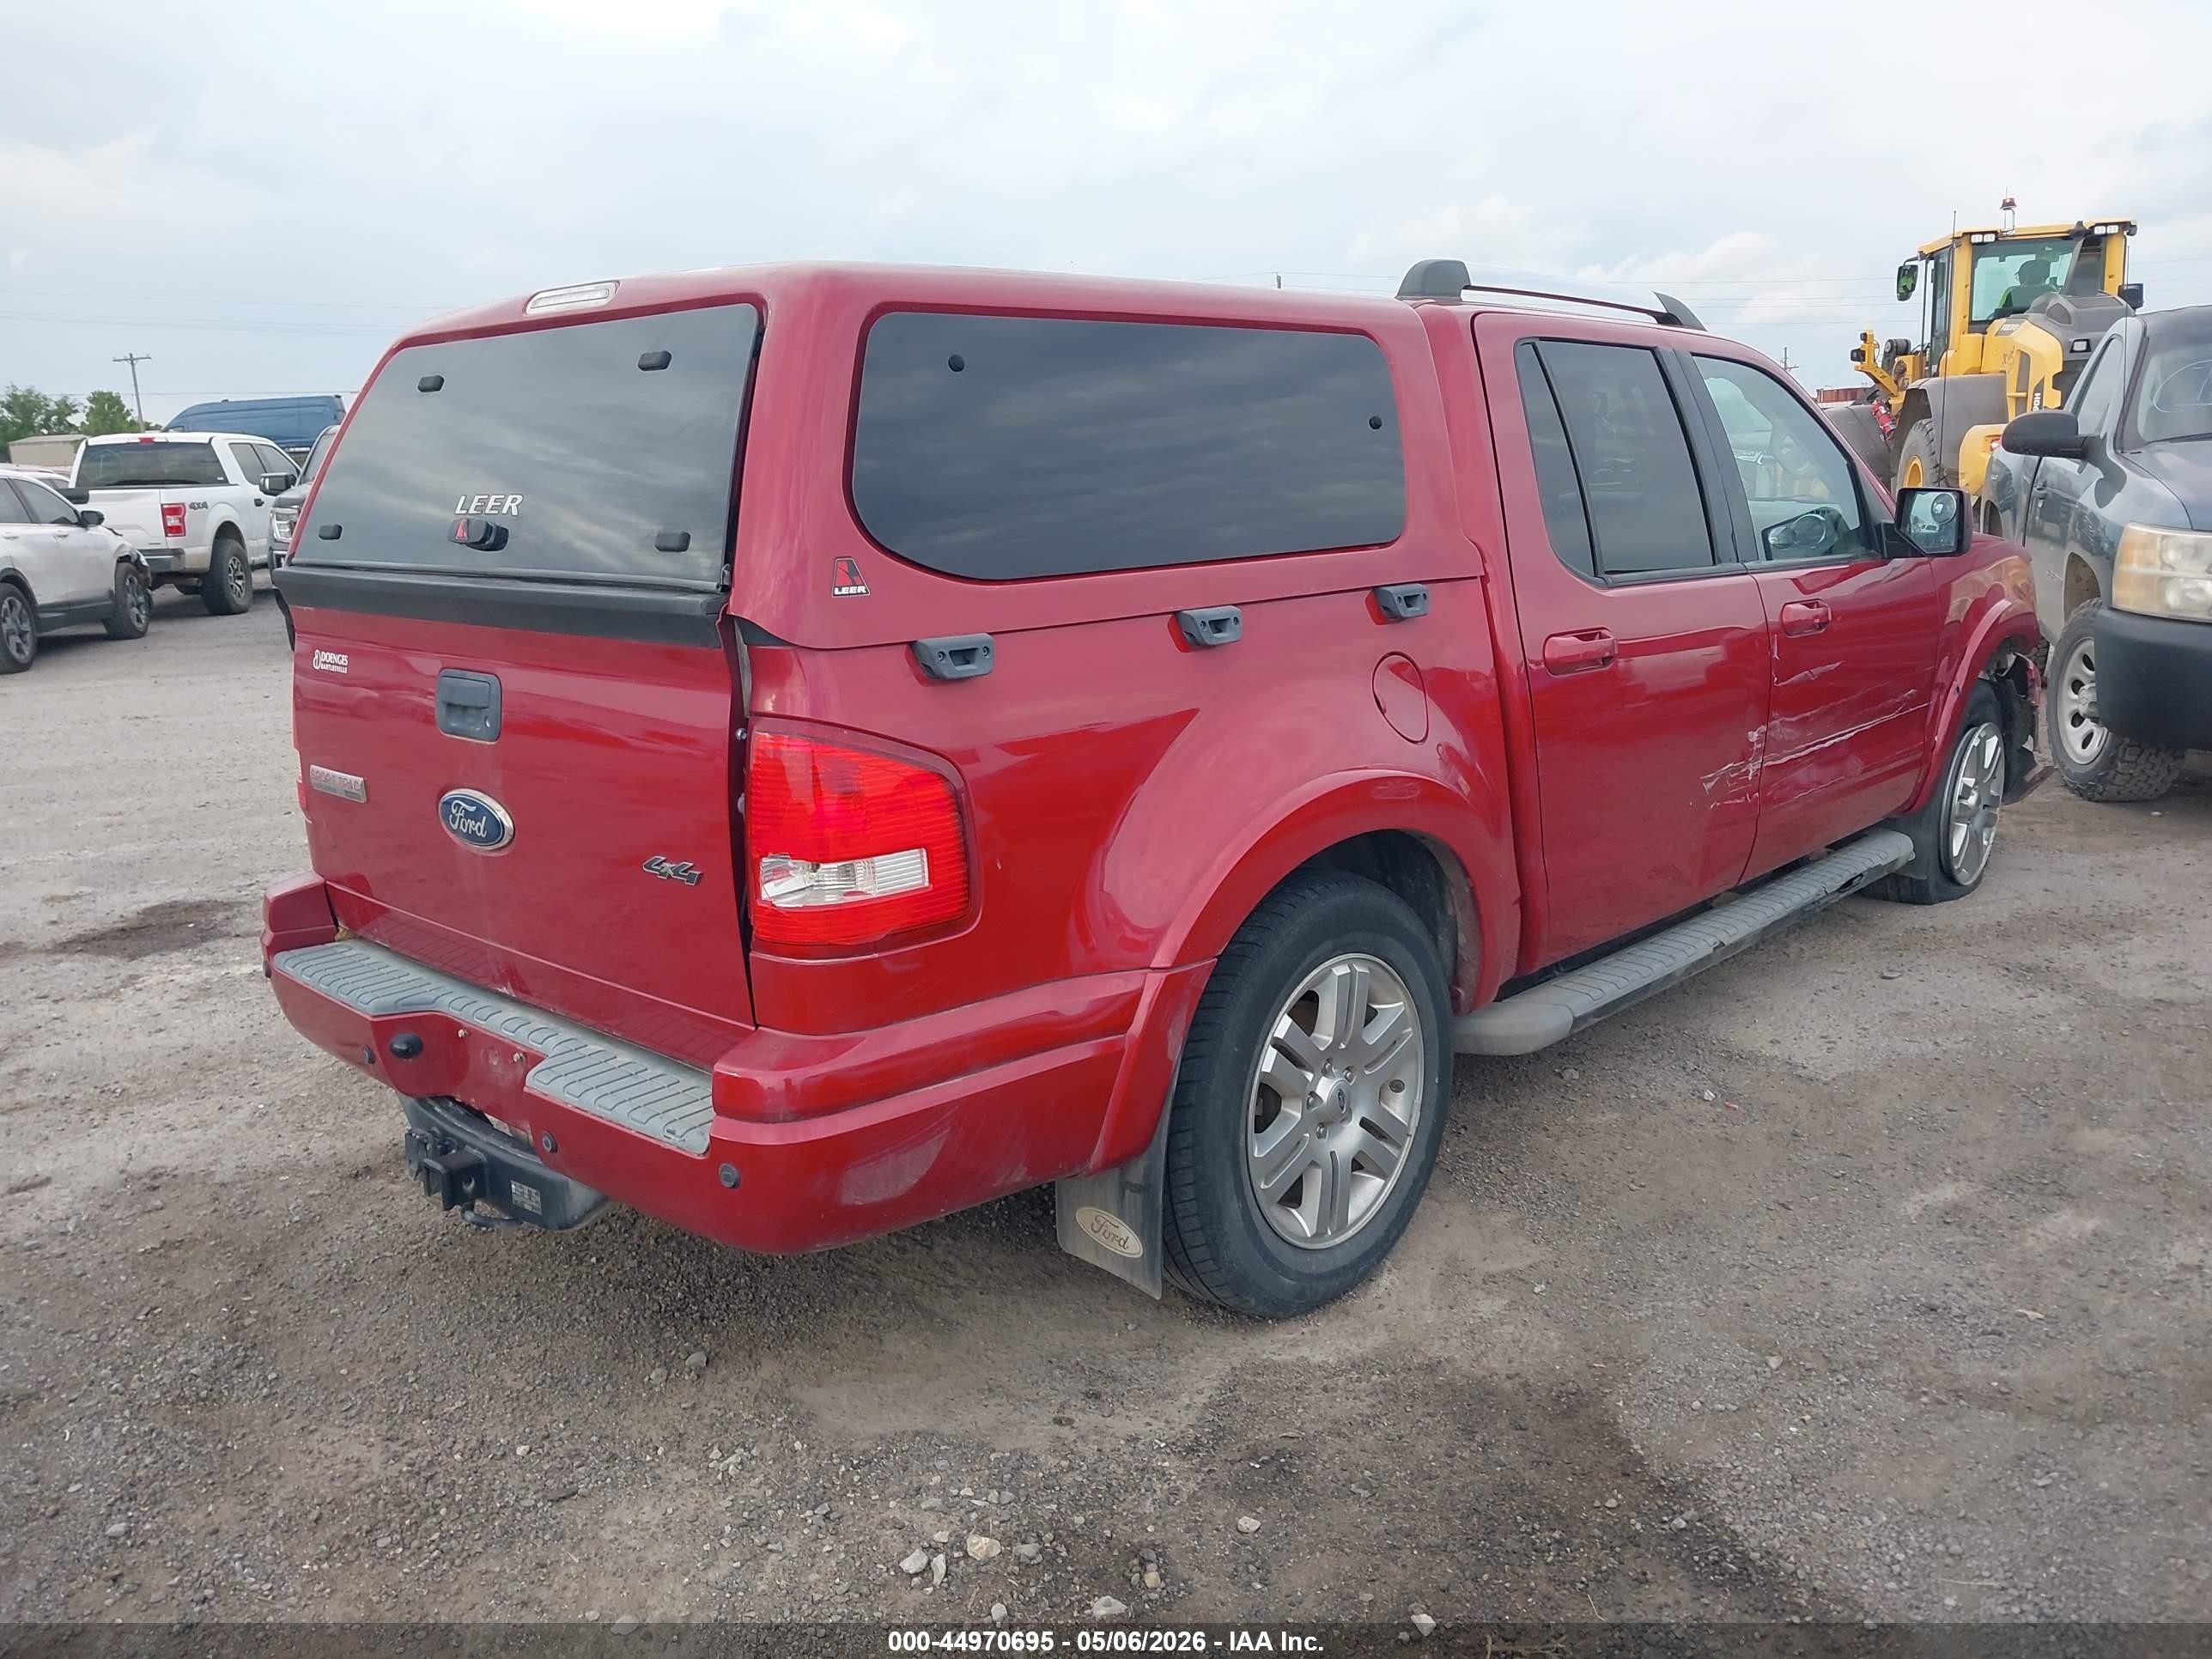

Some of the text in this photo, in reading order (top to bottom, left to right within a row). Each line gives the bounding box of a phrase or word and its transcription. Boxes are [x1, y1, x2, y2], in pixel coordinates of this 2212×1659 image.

[454, 494, 523, 516] LEER
[834, 586, 866, 595] LEER
[320, 651, 349, 666] DOENGES
[448, 799, 487, 838] Ford
[1091, 1214, 1129, 1250] Ford
